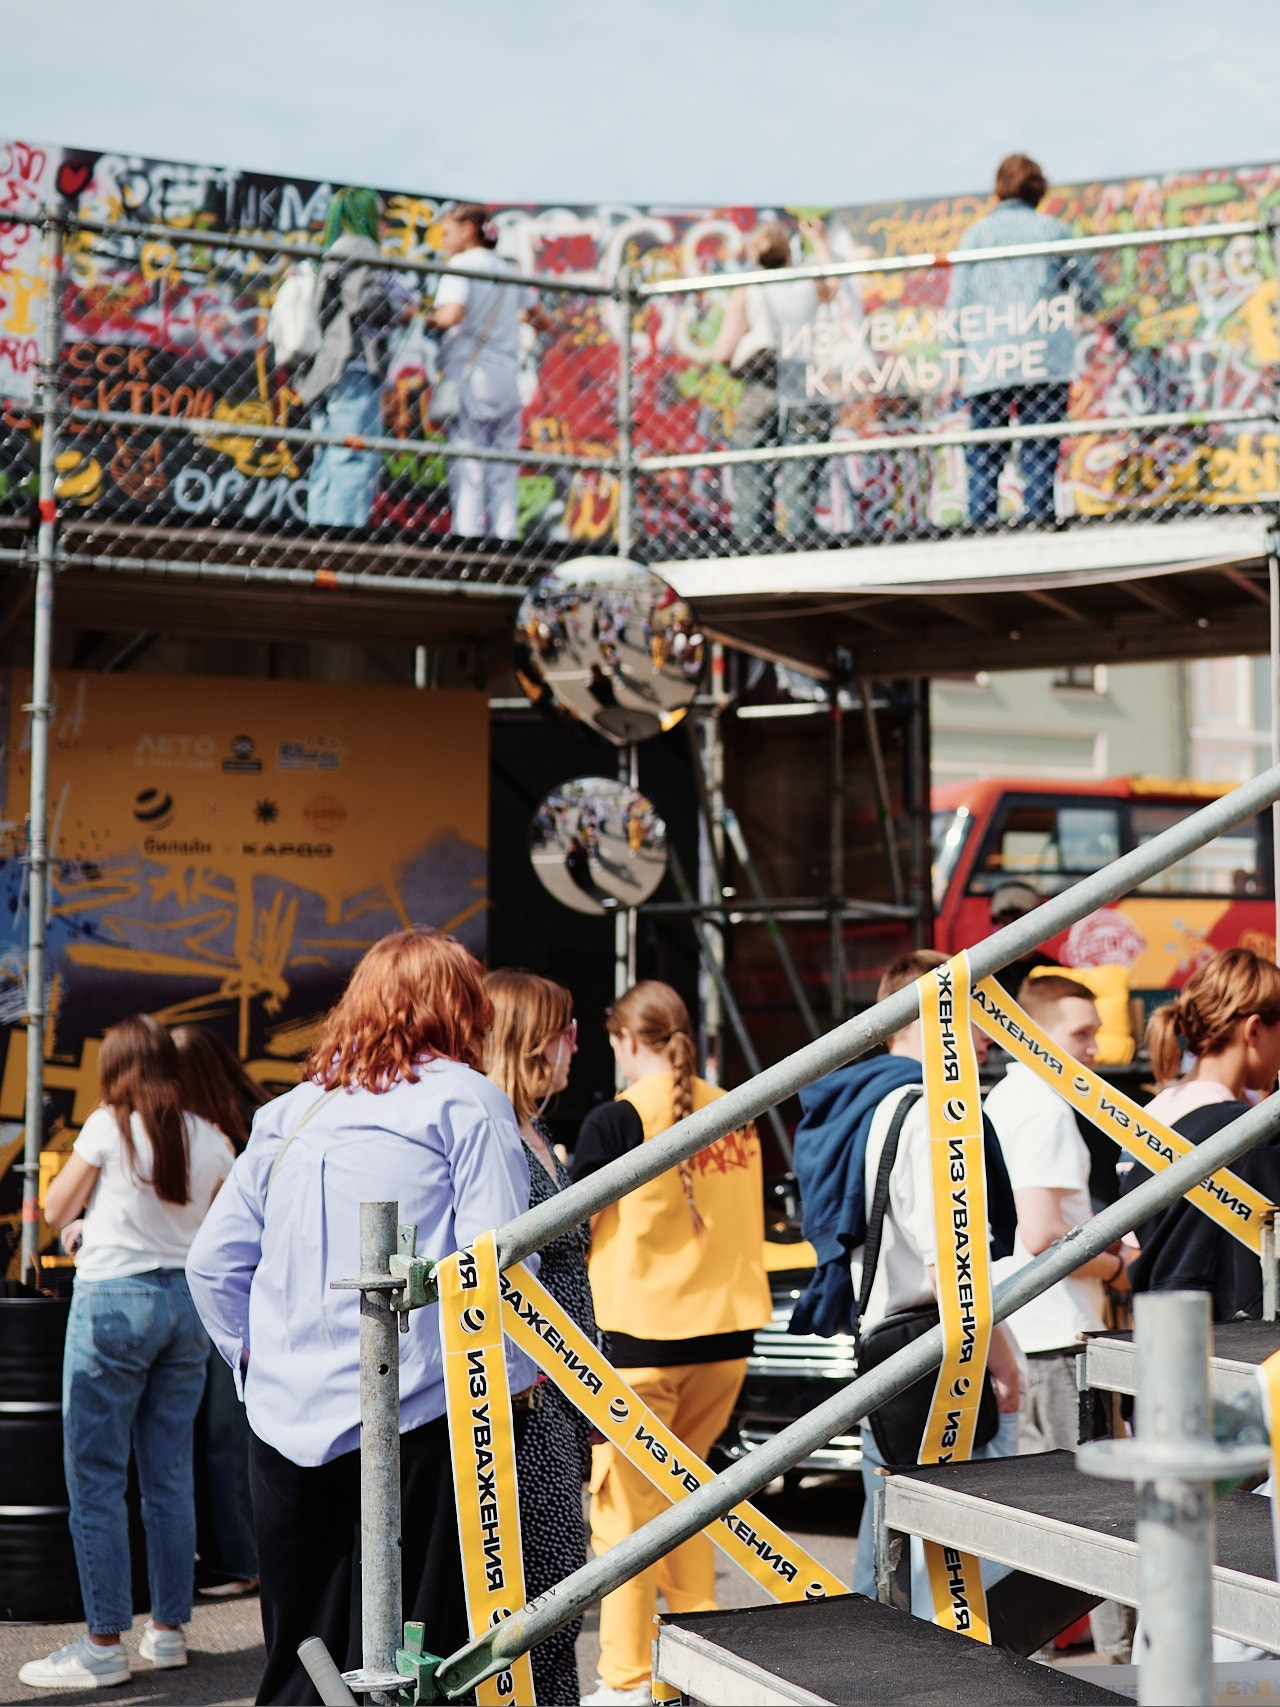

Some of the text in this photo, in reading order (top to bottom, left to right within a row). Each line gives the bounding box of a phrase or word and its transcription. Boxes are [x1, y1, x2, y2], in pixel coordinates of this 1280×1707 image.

[781, 297, 1076, 360] ИЗ УВАЖЕНИЯ
[804, 342, 1049, 397] К КУЛЬТУРЕ
[144, 837, 212, 856] билайн
[936, 964, 959, 1082] ЖЕНИЯ
[971, 985, 1063, 1076] АЖЕНИЯ
[1100, 1097, 1130, 1128] ИЗ
[949, 1138, 965, 1183] ИЗ
[951, 1188, 977, 1364] УВАЖЕНИЯ
[499, 1272, 603, 1396] ВАЖЕНИЯ
[634, 1425, 669, 1465] ИЗ
[941, 1411, 961, 1448] ИЗ
[467, 1350, 514, 1697] ИЗ УВАЖЕНИЯ З
